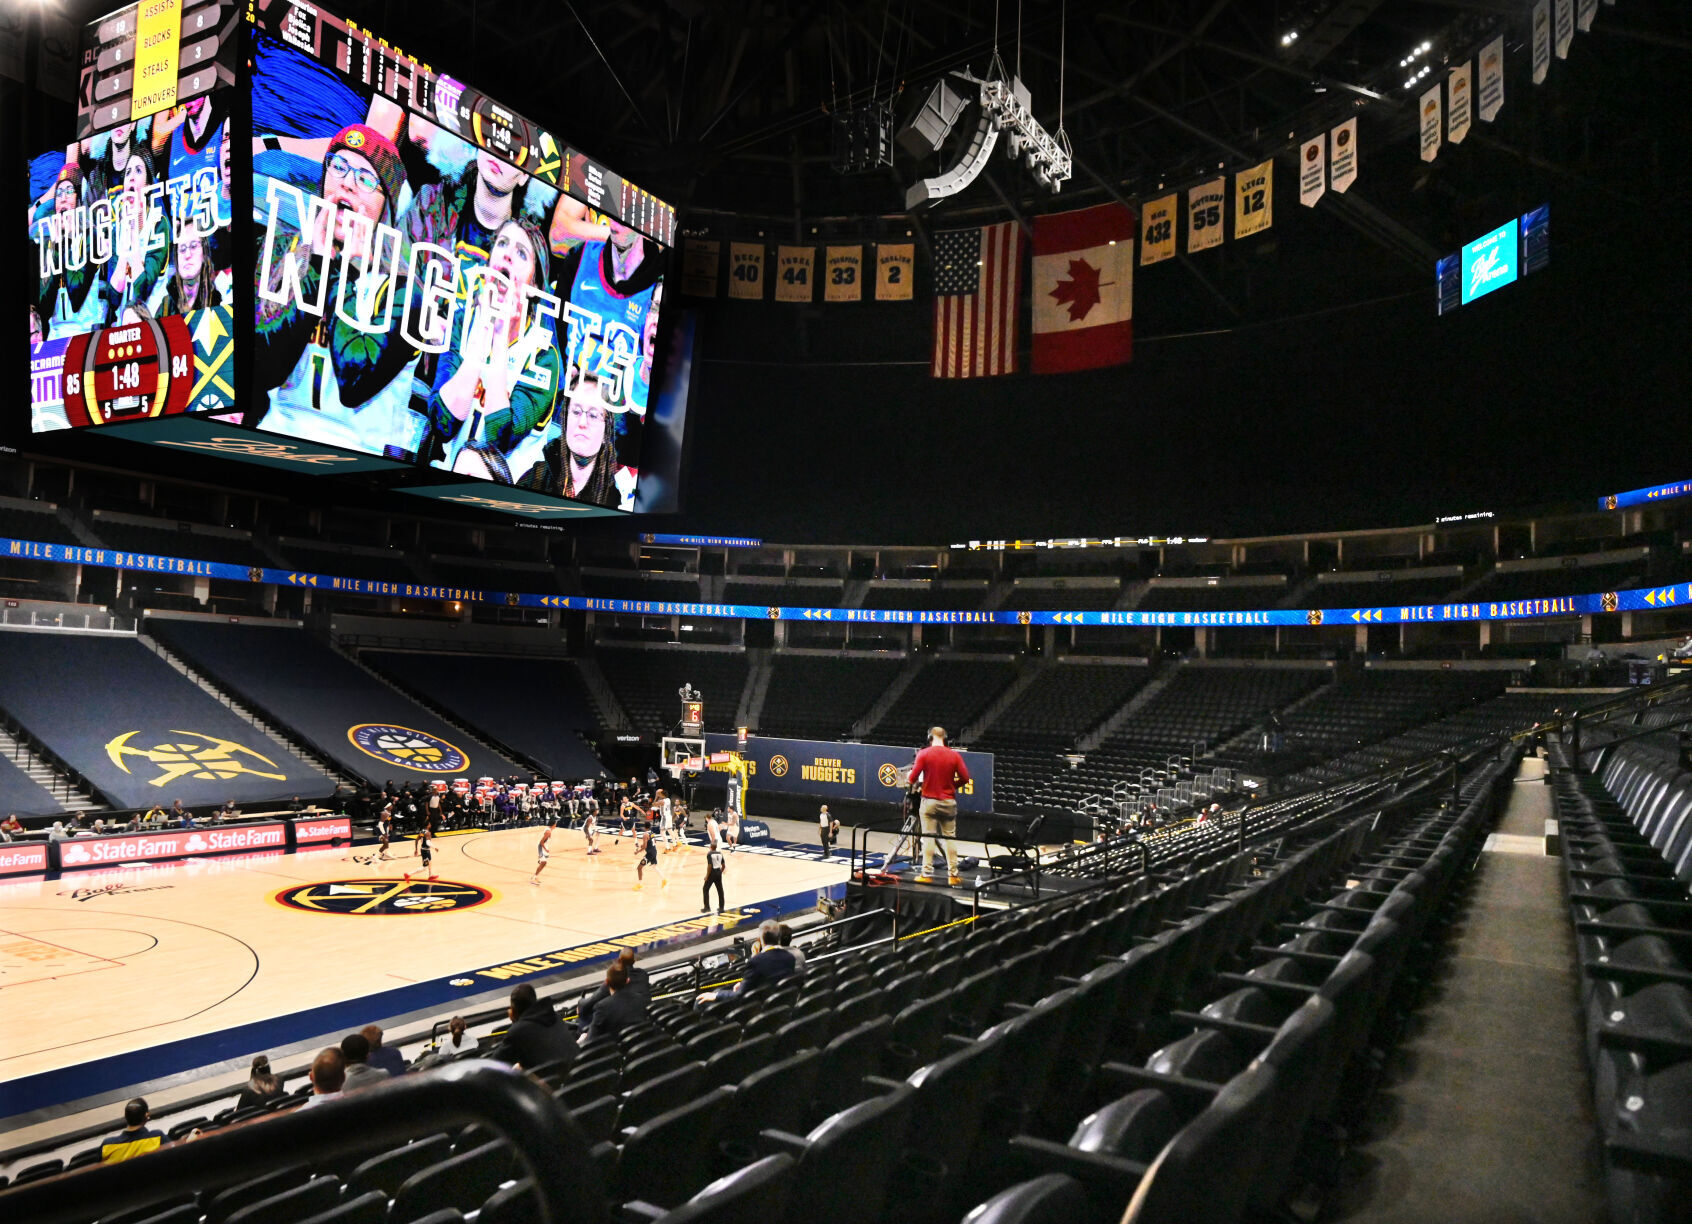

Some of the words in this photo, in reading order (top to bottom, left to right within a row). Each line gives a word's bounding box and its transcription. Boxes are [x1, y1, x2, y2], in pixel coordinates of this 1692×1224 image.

[116, 20, 126, 34] 19
[144, 0, 175, 18] ASSISTS
[294, 6, 307, 21] Fox
[115, 49, 121, 61] 6
[144, 28, 171, 49] BLOCKS
[113, 78, 120, 90] 3
[143, 59, 169, 79] STEALS
[195, 46, 201, 59] 3
[111, 107, 118, 119] 9
[133, 87, 176, 110] TURNOVERS
[193, 77, 200, 89] 9
[492, 122, 511, 145] 1:48
[1243, 190, 1265, 216] 12
[38, 167, 232, 279] NUGGETS
[1193, 205, 1220, 231] 55
[1145, 220, 1171, 245] 432
[734, 264, 759, 283] 40
[783, 267, 807, 285] 44
[832, 267, 856, 285] 33
[888, 266, 901, 284] 2
[258, 178, 646, 416] NUGGETS
[108, 327, 142, 346] QUARTER
[112, 362, 140, 391] 1:48
[172, 354, 188, 378] 84
[66, 373, 81, 396] 85
[104, 402, 111, 419] 5
[141, 396, 148, 413] 5
[1661, 485, 1679, 496] MILE
[10, 541, 53, 558] MILE
[64, 547, 104, 564] HIGH
[116, 553, 213, 575] BASKETBALL
[333, 578, 360, 591] MILE
[367, 581, 398, 594] HIGH
[406, 585, 485, 601] BASKETBALL
[586, 598, 615, 610] MILE
[622, 601, 650, 612] HIGH
[658, 603, 736, 616] BASKETBALL
[847, 610, 876, 621] MILE
[884, 611, 913, 622] HIGH
[920, 612, 995, 623] BASKETBALL
[1400, 604, 1434, 620] MILE
[1443, 603, 1480, 619] HIGH
[1490, 598, 1575, 617] BASKETBALL
[1100, 612, 1133, 624] MILE
[1141, 612, 1175, 624] HIGH
[1184, 612, 1269, 624] BASKETBALL
[691, 711, 699, 722] 6
[358, 731, 371, 746] MILE
[406, 731, 438, 743] CITY
[394, 755, 460, 770] BASKETBALL
[814, 757, 842, 768] DENVER
[801, 764, 856, 784] NUGGETS
[476, 957, 565, 980] MILE
[554, 942, 616, 963] HIGH
